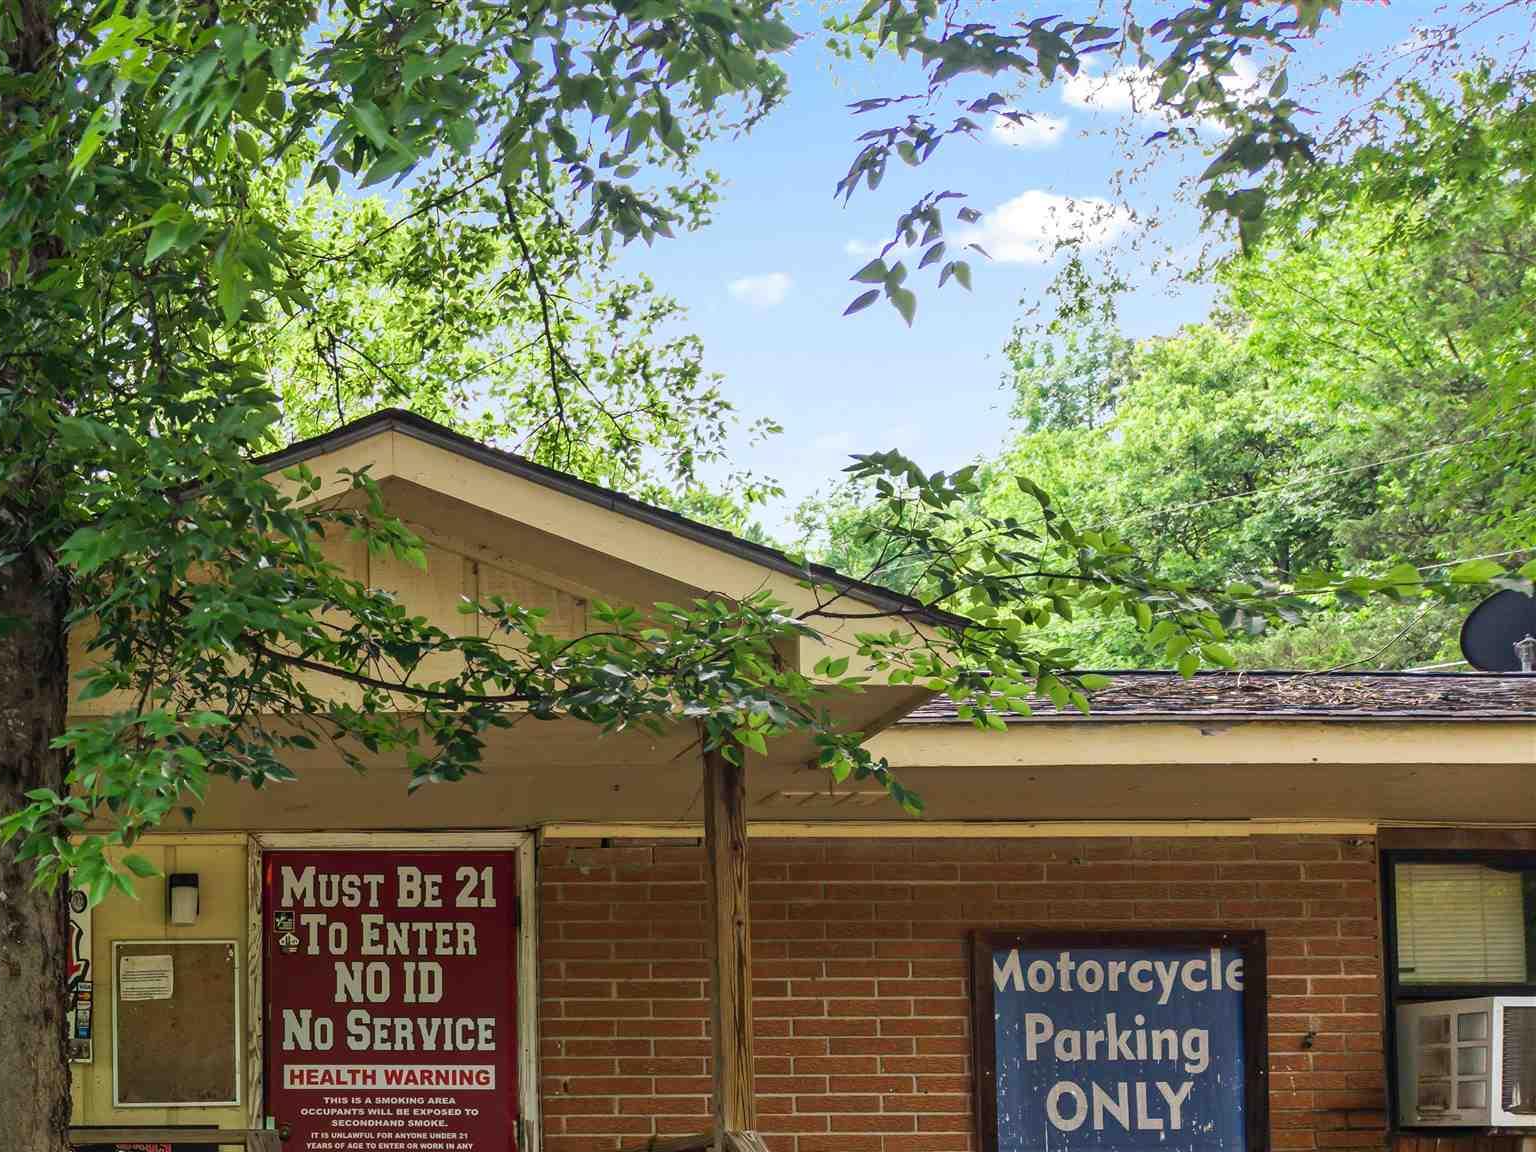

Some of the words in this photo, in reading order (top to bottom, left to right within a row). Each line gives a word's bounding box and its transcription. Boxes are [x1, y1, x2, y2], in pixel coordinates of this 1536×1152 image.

[281, 866, 384, 908] MUST
[397, 866, 442, 908] BE
[456, 866, 496, 908] 21
[300, 914, 348, 955] TO
[362, 914, 477, 955] ENTER
[335, 962, 390, 1002] NO
[404, 962, 442, 1002] ID
[993, 949, 1244, 1004] Motorcycle
[282, 1009, 333, 1050] NO
[346, 1009, 496, 1050] SERVICE
[1025, 1013, 1208, 1073] Parking
[289, 1070, 376, 1086] HEALTH
[384, 1070, 491, 1086] WARNING
[367, 1108, 393, 1116] WILL
[396, 1108, 410, 1116] BE
[414, 1108, 461, 1116] EXPOSED
[408, 1119, 448, 1127] SMOKE.
[1046, 1081, 1194, 1131] ONLY
